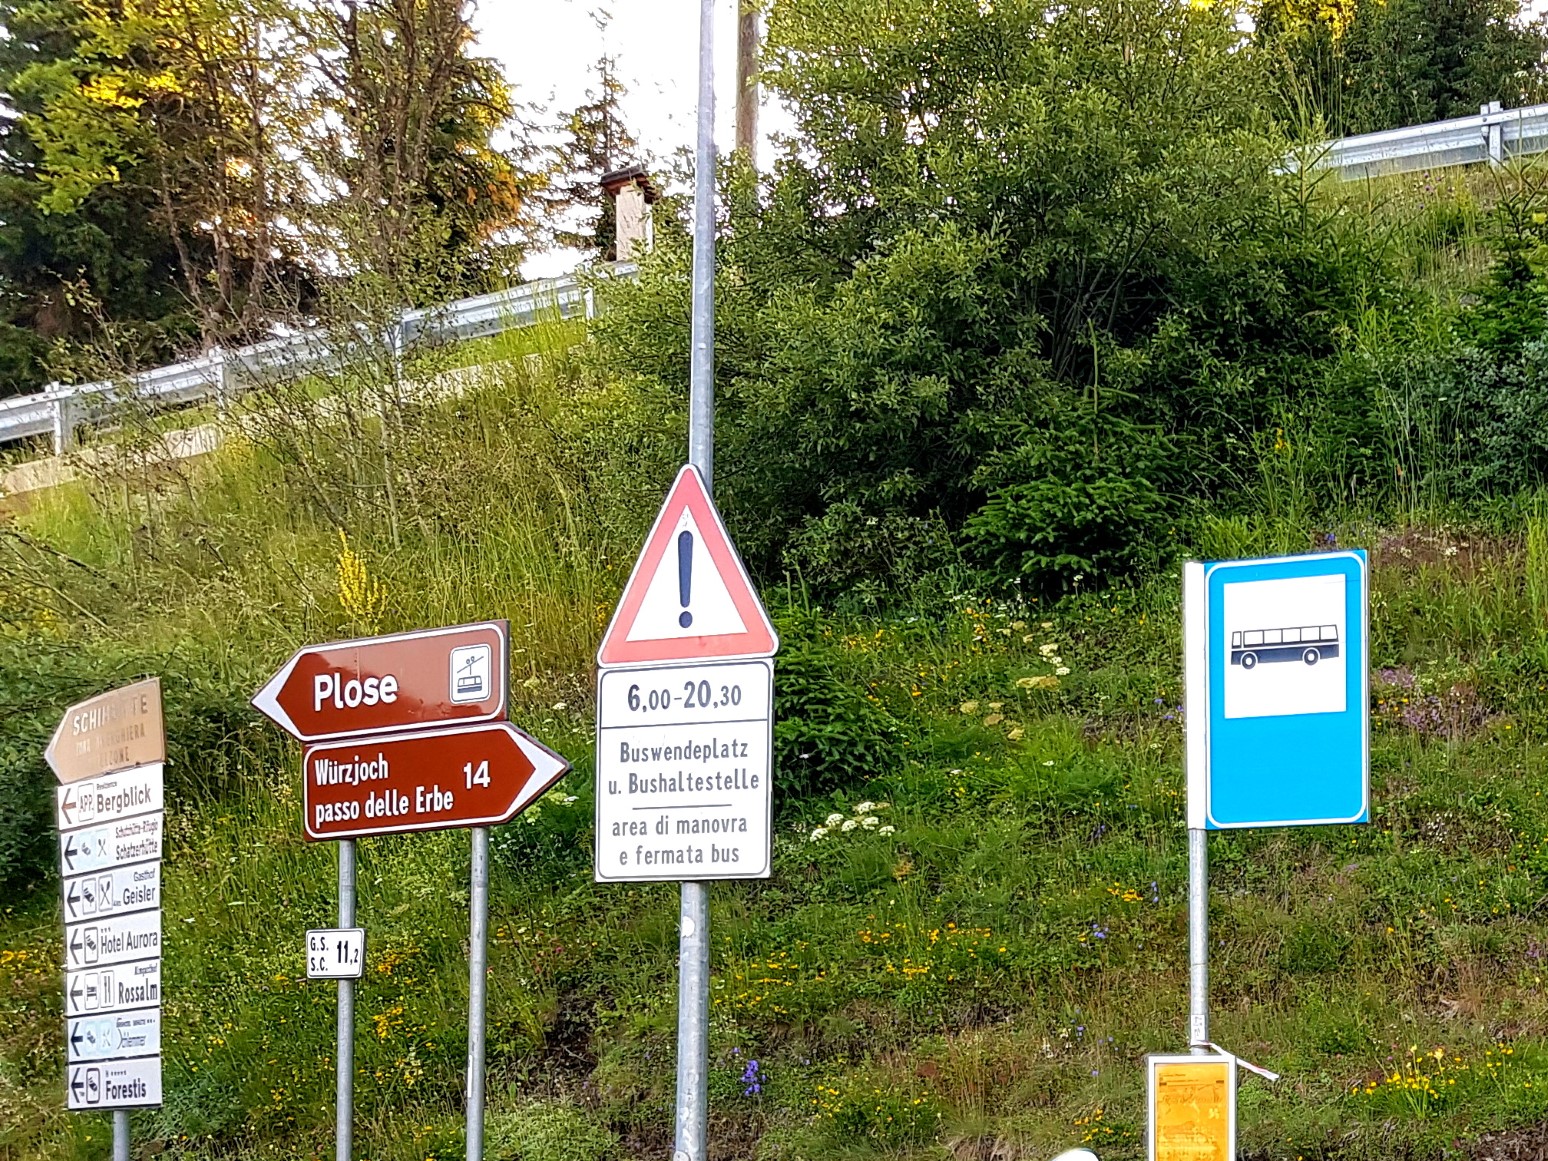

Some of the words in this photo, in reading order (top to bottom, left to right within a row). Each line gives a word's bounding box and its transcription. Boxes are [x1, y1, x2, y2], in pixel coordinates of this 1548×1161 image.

[314, 672, 398, 712] Plose
[72, 693, 148, 737] SCHIHTE
[620, 738, 749, 763] Buswendeplatz
[315, 752, 389, 788] Würzjoch
[463, 761, 491, 789] 14
[608, 780, 622, 795] u.
[629, 768, 760, 794] Bushaltestelle
[97, 784, 151, 814] Bergblick
[315, 801, 359, 829] passo
[365, 789, 409, 819] delle
[415, 785, 454, 813] Erbe
[612, 821, 648, 836] area
[655, 815, 669, 835] di
[676, 817, 748, 835] manovra
[619, 851, 628, 866] e
[636, 845, 704, 865] fermata
[711, 844, 740, 863] bus
[123, 885, 156, 905] Geisler
[101, 932, 124, 954] Hotel
[126, 931, 158, 951] Aurora
[310, 936, 329, 951] G.S.
[310, 957, 328, 972] S.C.
[119, 978, 158, 1004] Rossalm
[105, 1077, 147, 1100] Forestis
